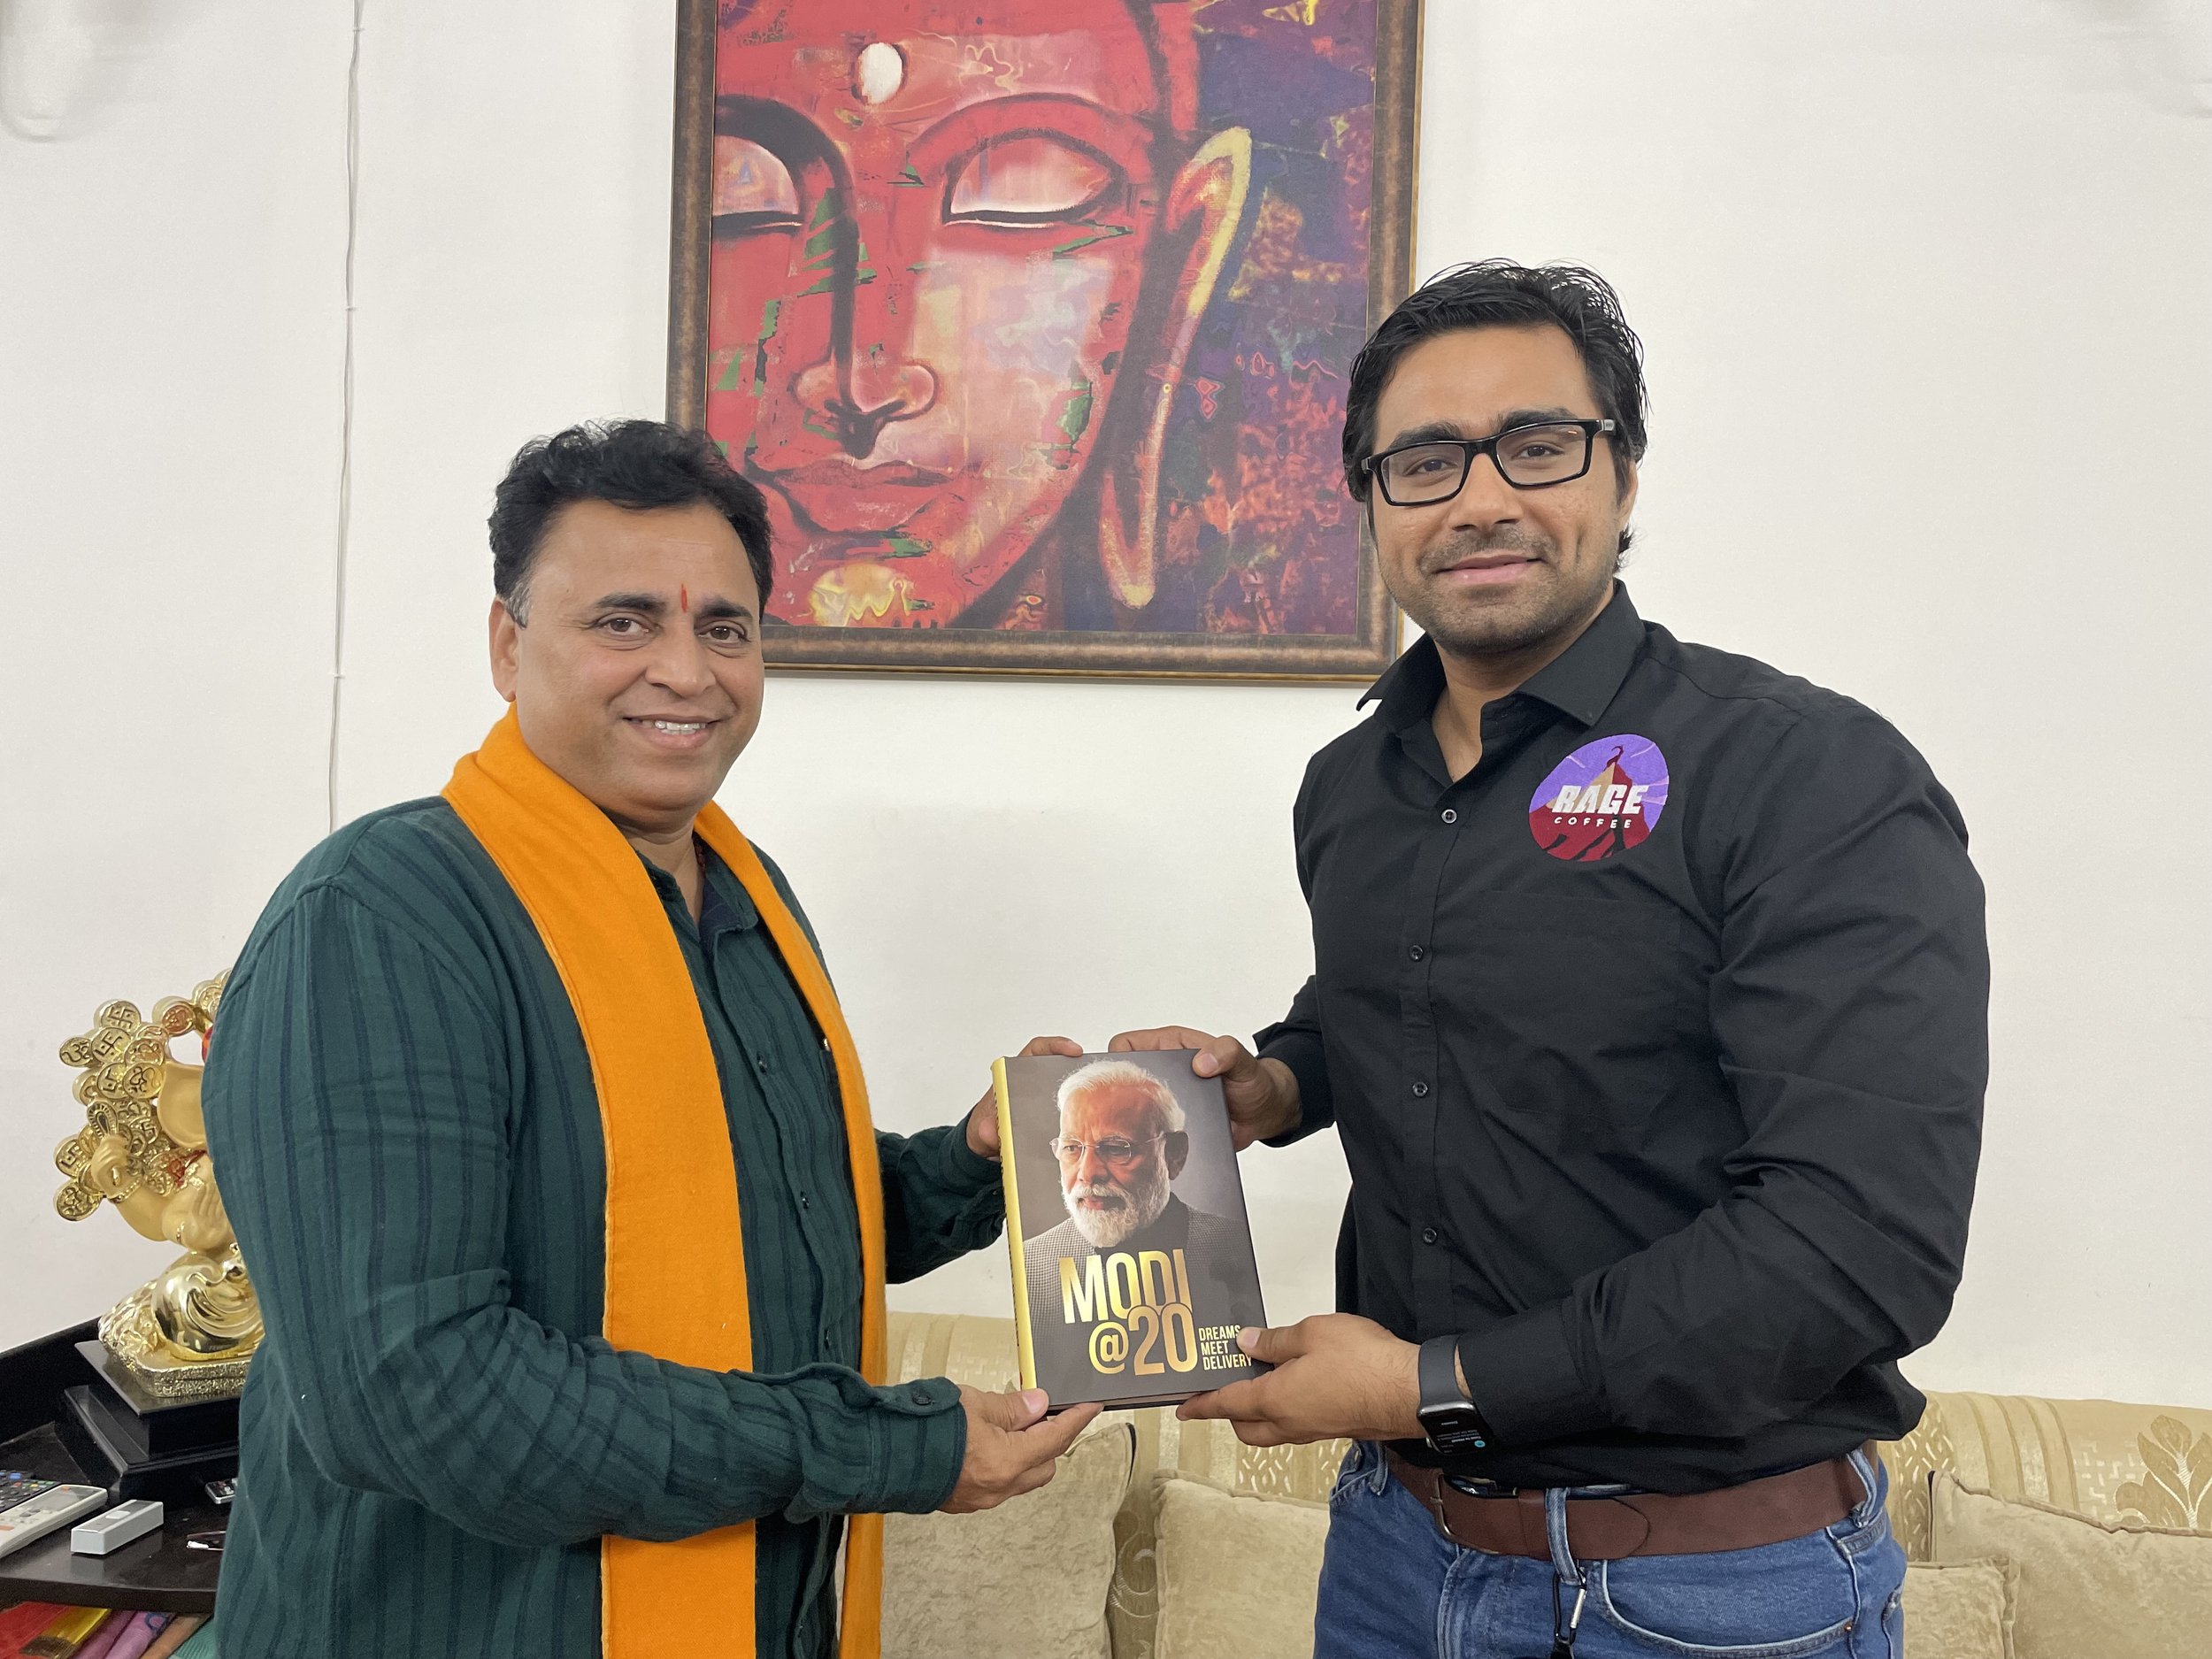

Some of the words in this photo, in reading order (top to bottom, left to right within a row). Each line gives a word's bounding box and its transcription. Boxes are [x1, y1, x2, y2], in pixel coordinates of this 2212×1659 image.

[1552, 785, 1648, 814] RAGE
[1554, 817, 1632, 828] COFFEE
[1059, 1248, 1193, 1324] MODI
[1088, 1302, 1198, 1376] @20
[1198, 1324, 1241, 1341] DREAMS
[1200, 1340, 1229, 1356] MEET
[1202, 1353, 1252, 1371] DELIVERY
